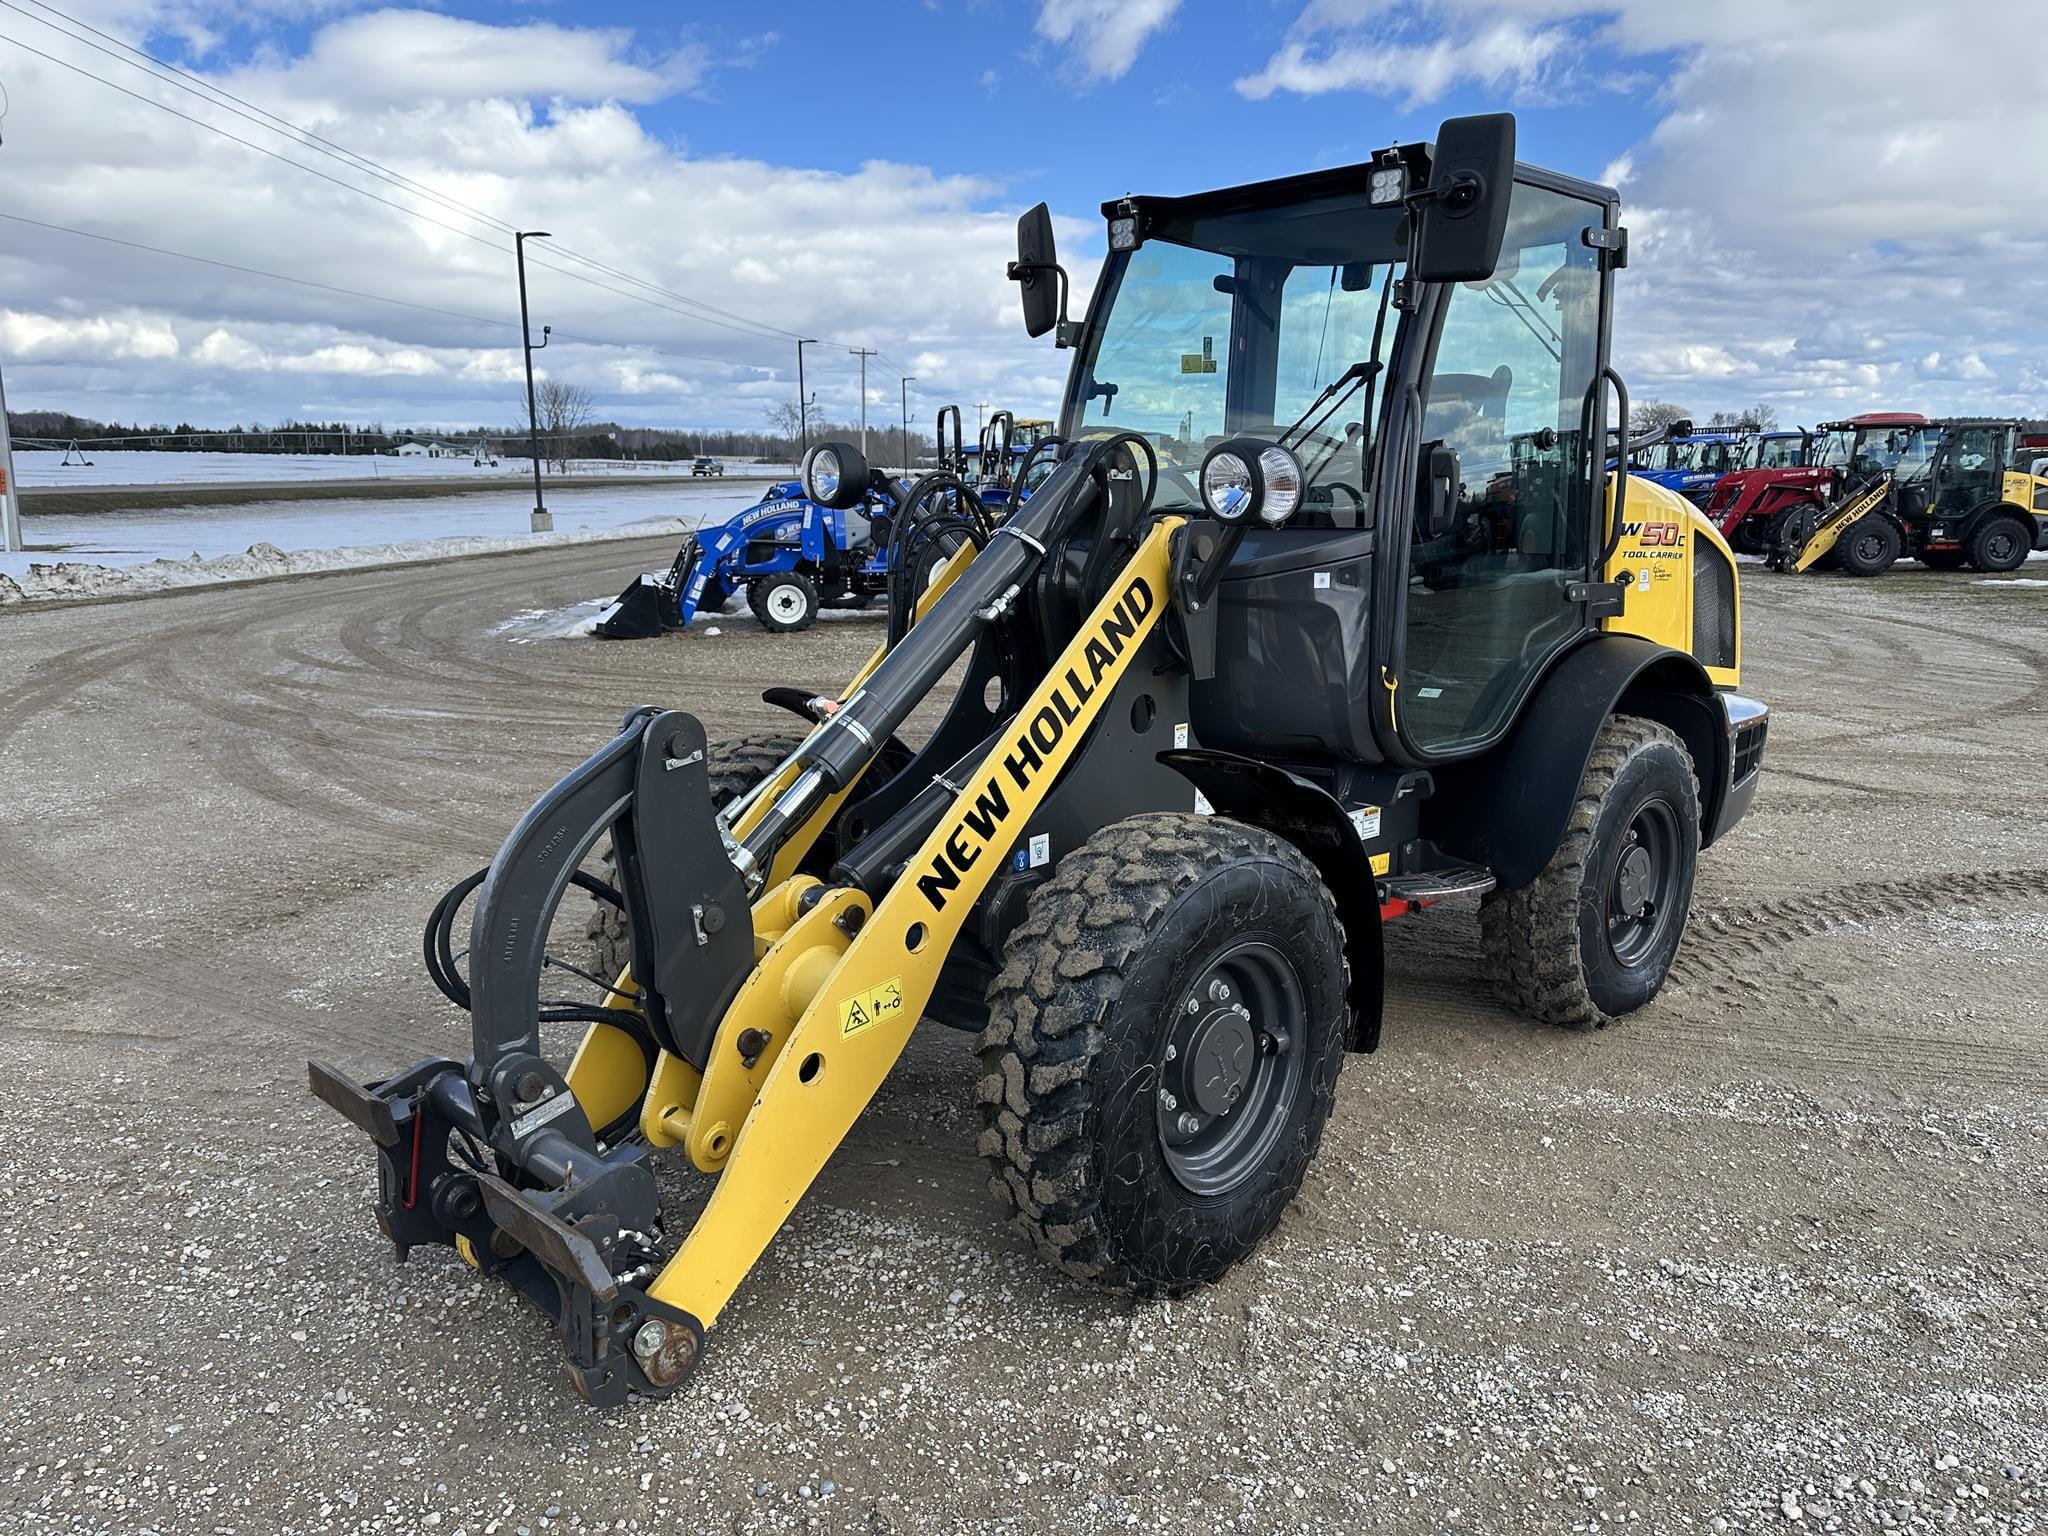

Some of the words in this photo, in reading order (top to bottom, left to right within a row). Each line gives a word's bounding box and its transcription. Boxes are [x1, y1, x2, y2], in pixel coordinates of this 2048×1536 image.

[743, 512, 760, 525] NEW
[761, 501, 799, 515] HOLLAND
[1835, 514, 1853, 531] NEW
[1852, 488, 1885, 517] HOLLAND
[1622, 550, 1648, 559] TOOL
[1649, 550, 1684, 560] CARRIER
[916, 776, 1011, 912] NEW
[1003, 576, 1154, 792] HOLLAND
